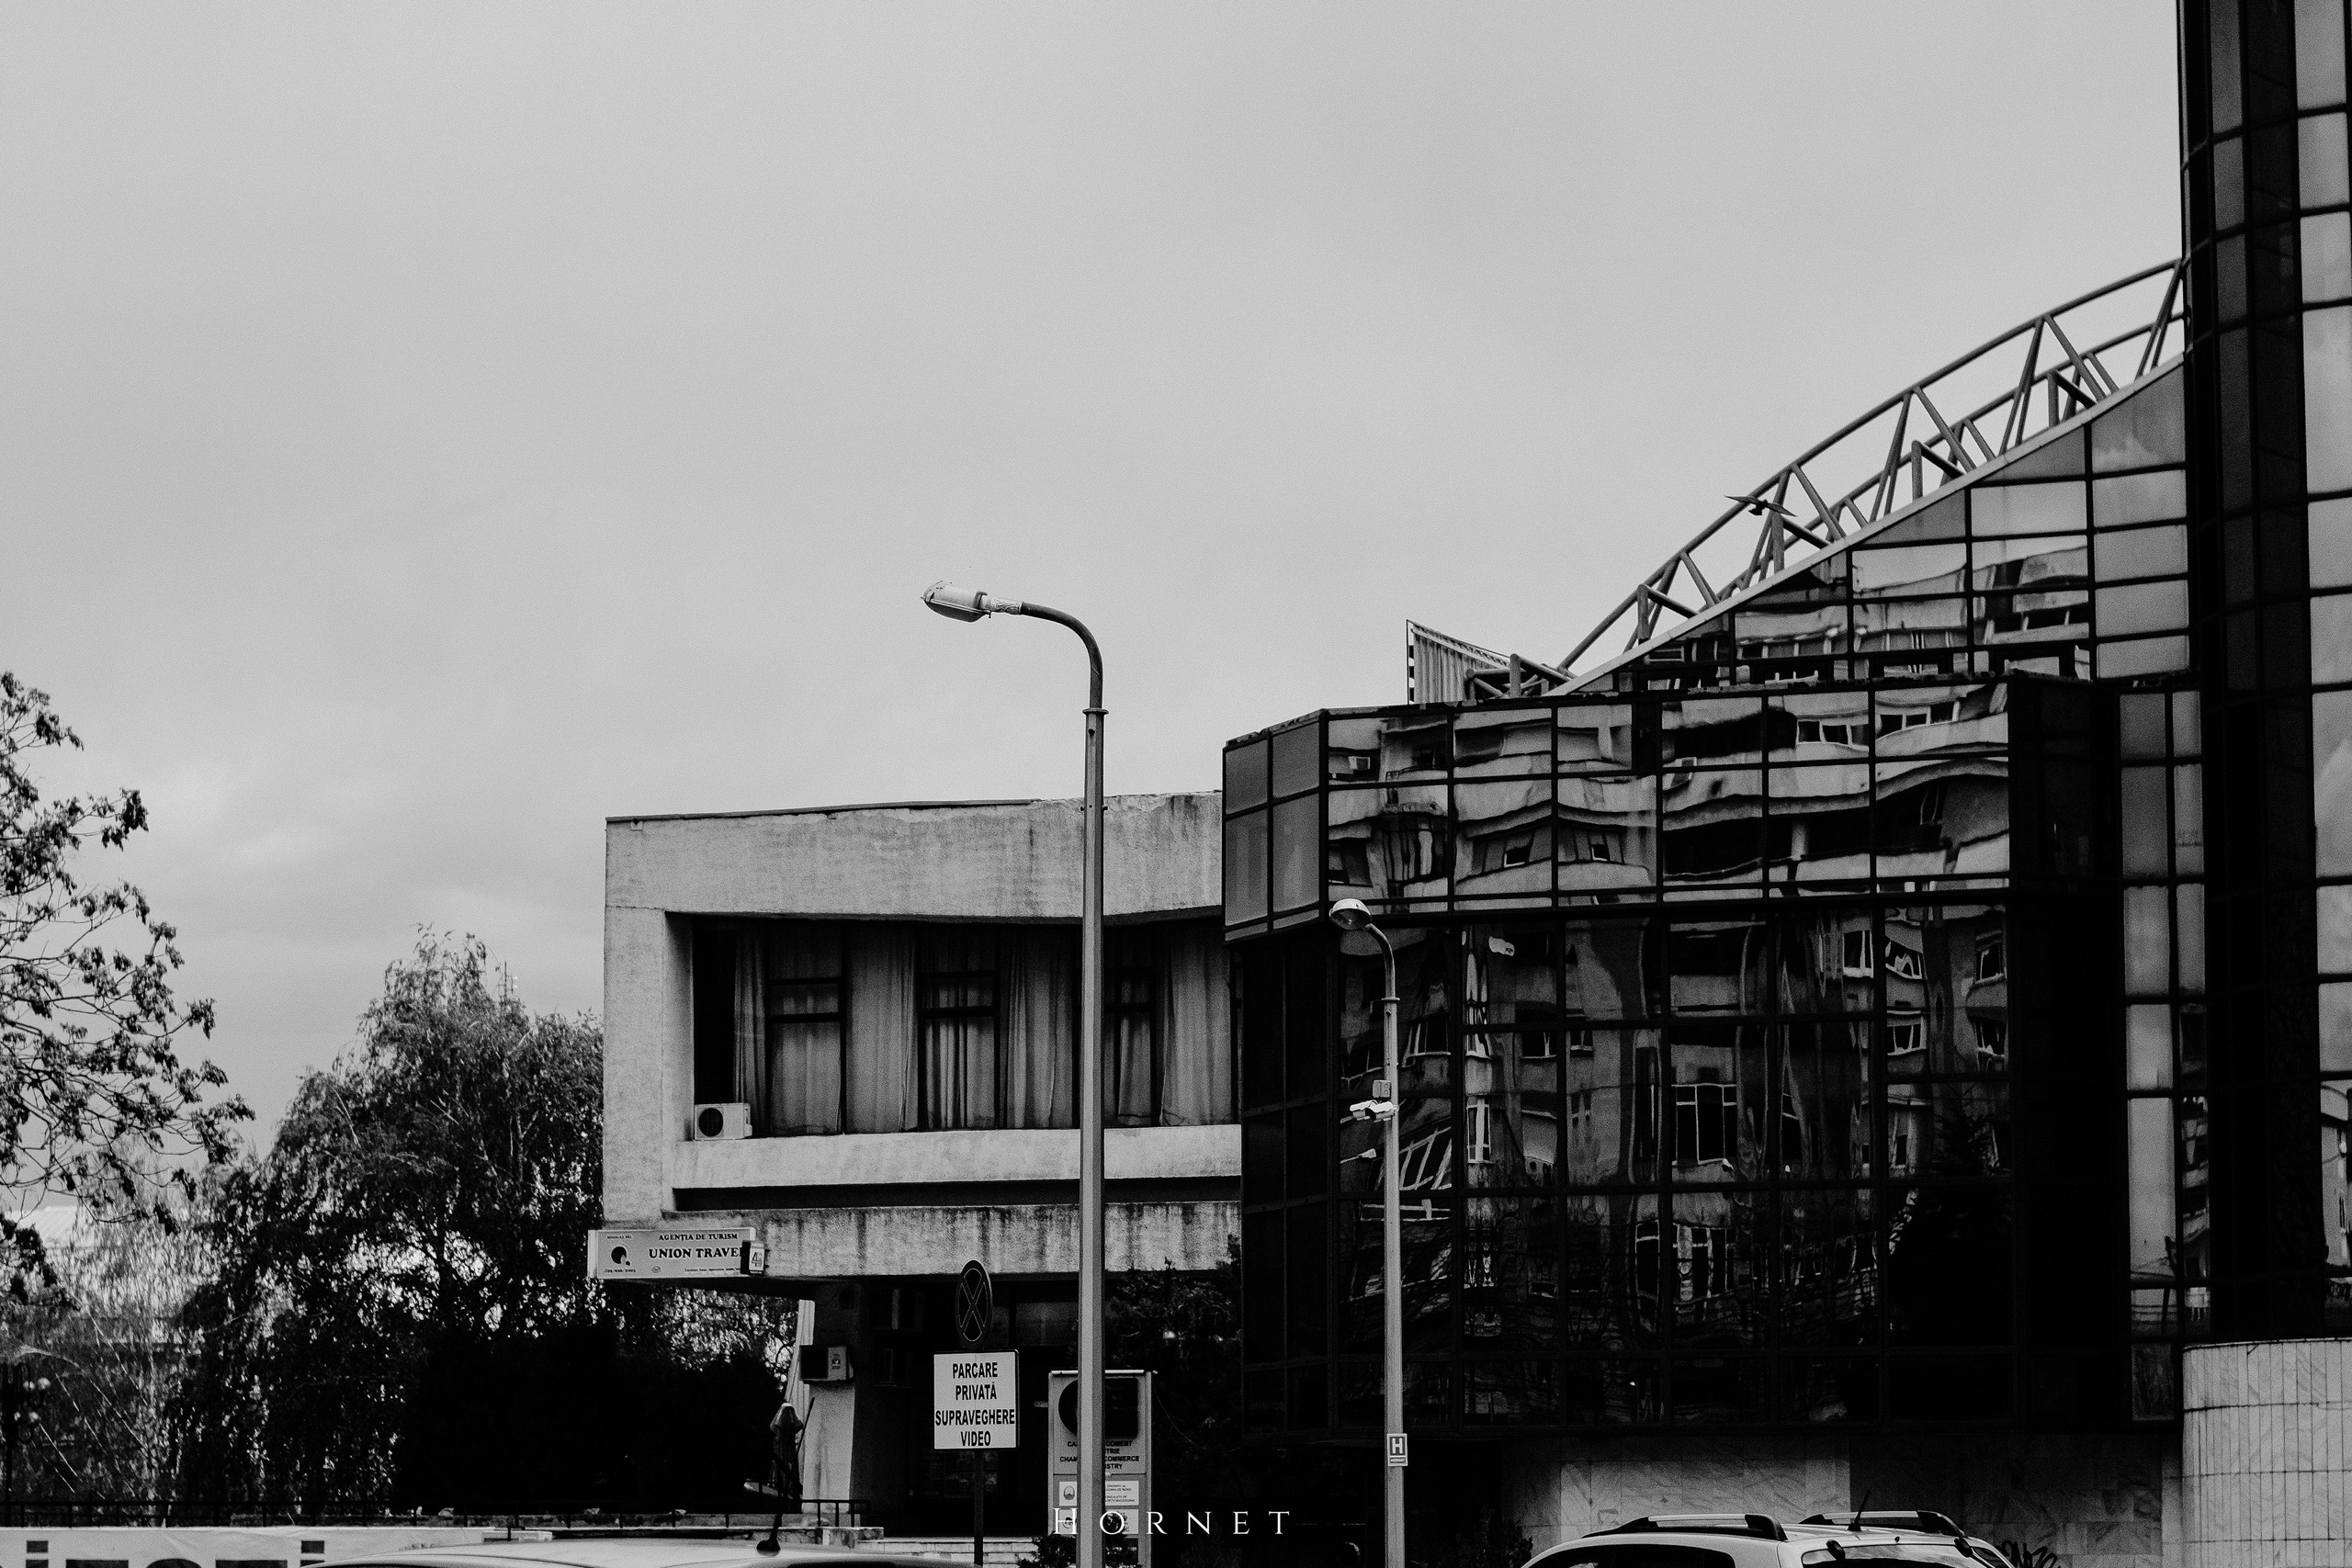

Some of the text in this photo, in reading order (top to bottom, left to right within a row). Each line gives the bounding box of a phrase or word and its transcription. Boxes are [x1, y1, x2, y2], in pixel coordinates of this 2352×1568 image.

[649, 1248, 691, 1258] UNION
[952, 1362, 998, 1379] PARCARE
[956, 1382, 997, 1400] PRIVATĂ
[935, 1409, 1015, 1426] SUPRAVEGHERE
[960, 1430, 991, 1447] VIDEO
